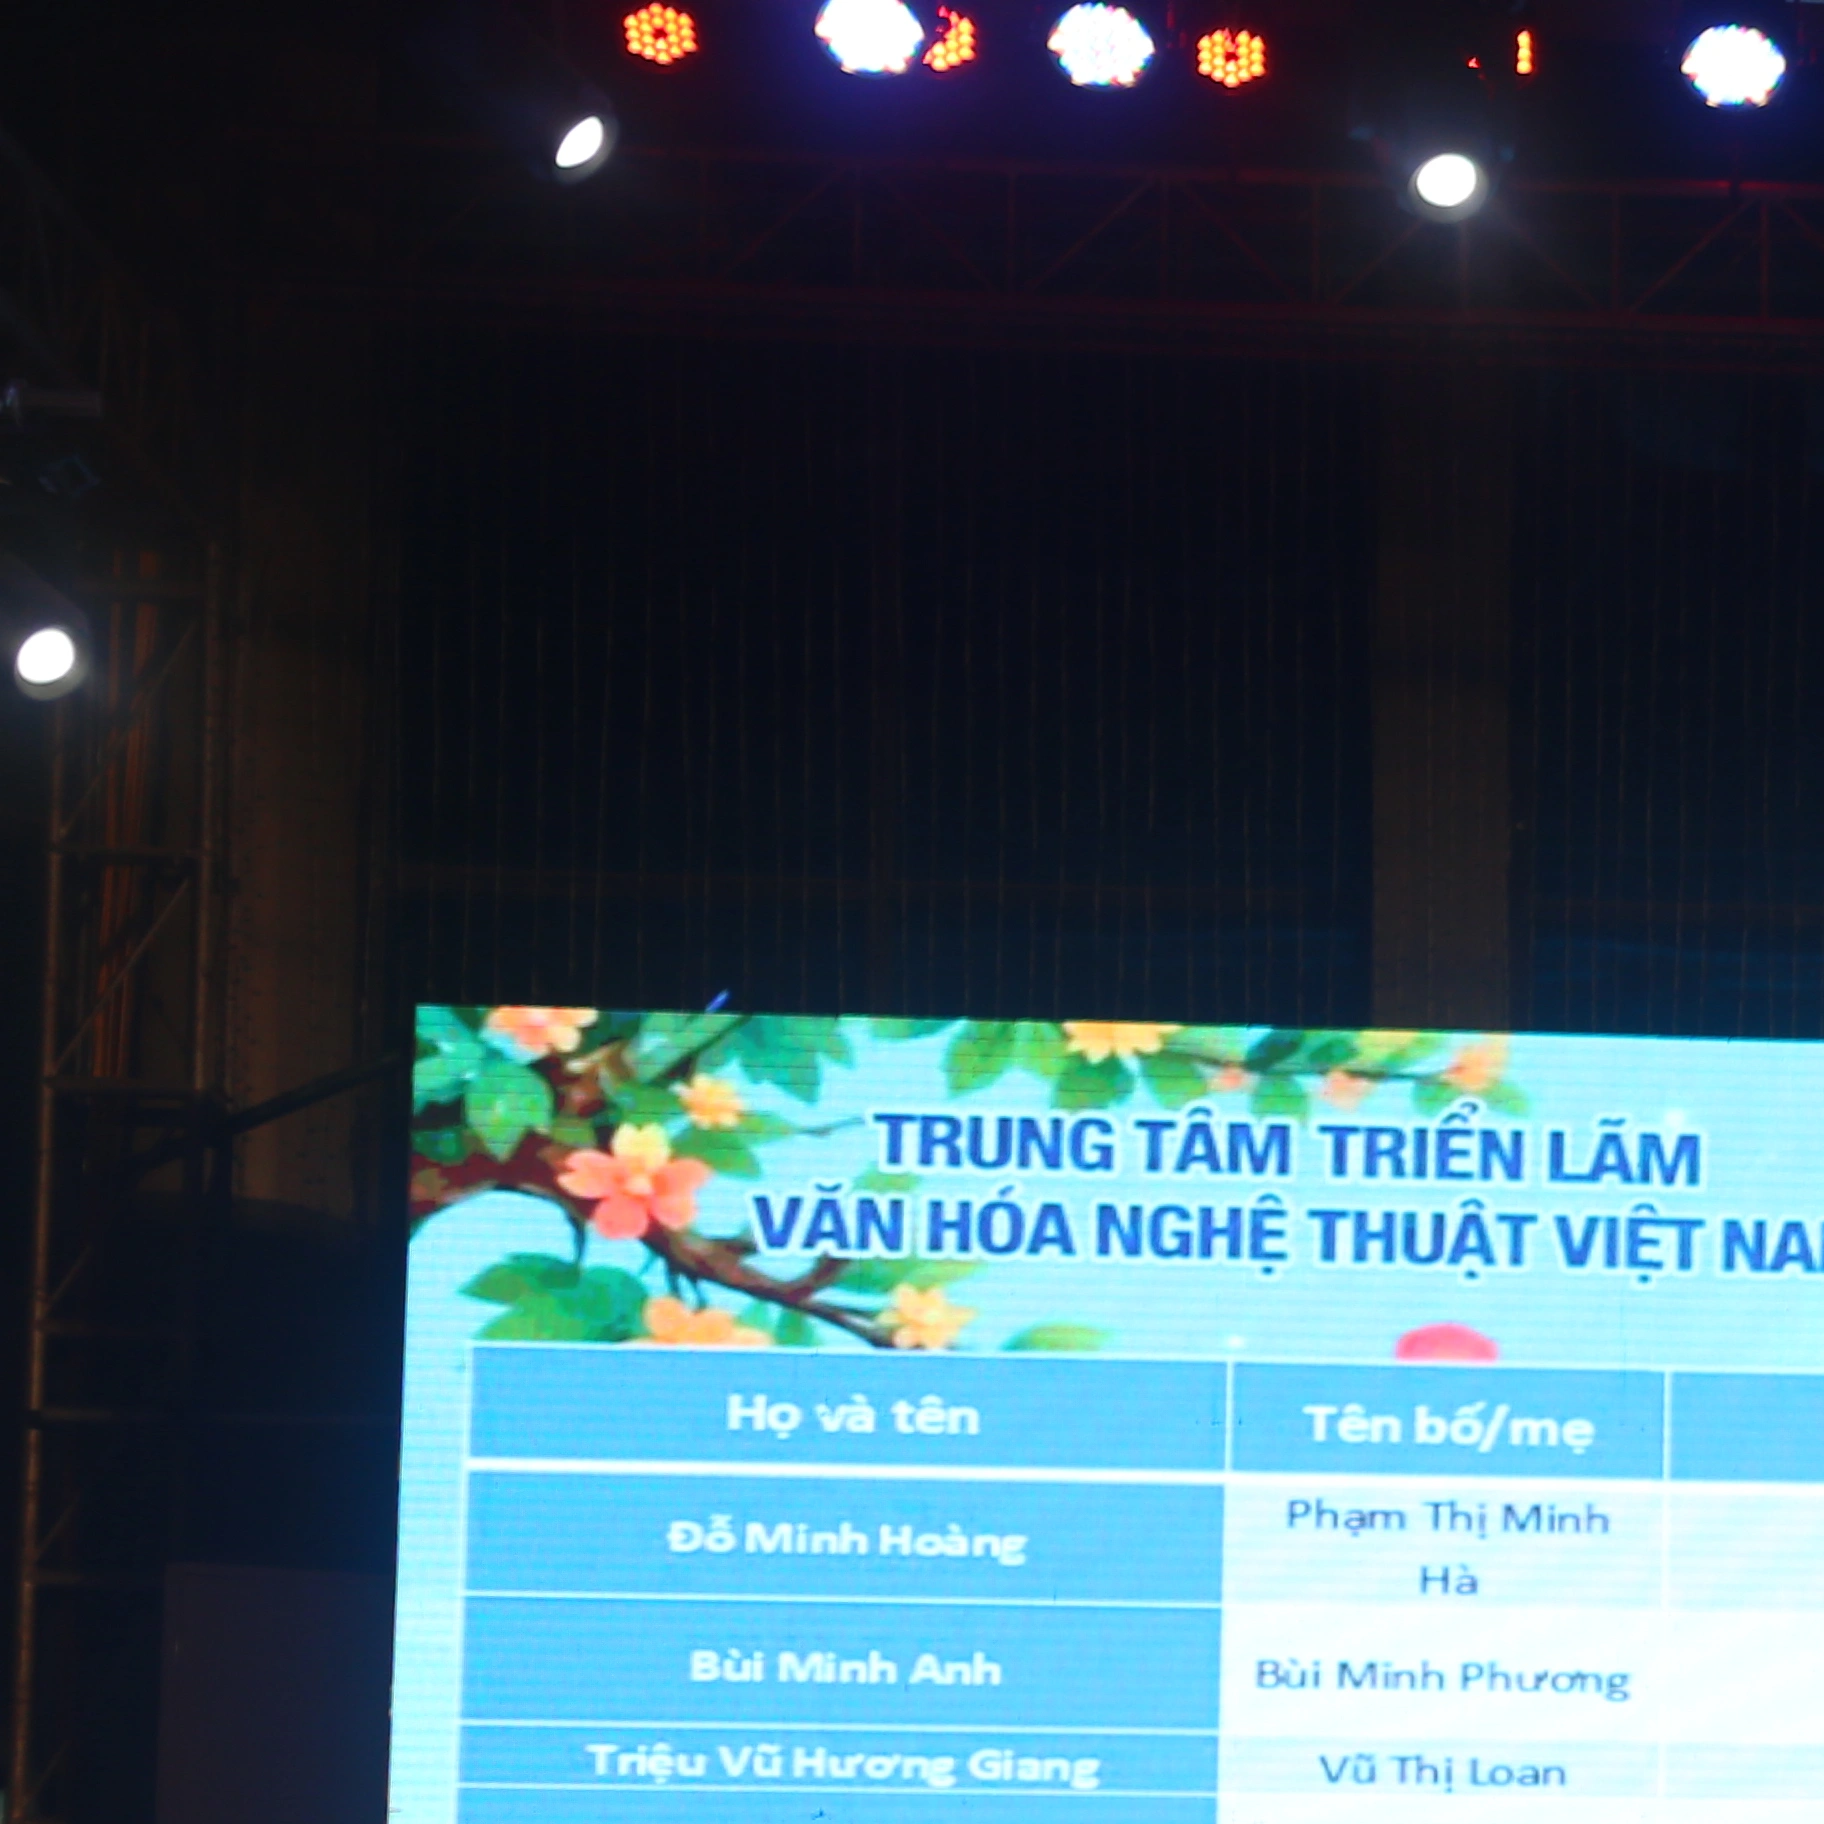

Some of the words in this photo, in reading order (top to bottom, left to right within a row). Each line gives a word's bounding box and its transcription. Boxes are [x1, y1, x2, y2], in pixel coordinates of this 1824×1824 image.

[873, 1112, 1115, 1172] TRUNG
[1134, 1106, 1292, 1176] TÂM
[1317, 1102, 1525, 1182] TRIỂN
[1548, 1117, 1701, 1187] LÃM
[751, 1183, 905, 1251] VĂN
[926, 1184, 1077, 1257] HÓA
[1095, 1191, 1289, 1276] NGHỆ
[1306, 1197, 1539, 1281] THUẬT
[1553, 1201, 1707, 1284] VIỆT
[726, 1393, 804, 1441] Họ
[814, 1392, 877, 1434] và
[889, 1393, 981, 1436] tên
[1301, 1402, 1403, 1445] Tên
[1413, 1400, 1596, 1455] bố/mẹ
[665, 1513, 738, 1554] Đỗ
[744, 1521, 871, 1556] Minh
[877, 1522, 1030, 1568] Hoàng
[1285, 1496, 1408, 1538] Phạm
[1422, 1497, 1489, 1541] Thị
[1500, 1501, 1611, 1535] Minh
[1418, 1562, 1480, 1597] Hà
[689, 1647, 766, 1683] Bùi
[776, 1649, 899, 1685] Minh
[908, 1650, 1003, 1687] Anh
[1254, 1657, 1323, 1692] Bùi
[1335, 1658, 1447, 1693] Minh
[1458, 1658, 1632, 1704] Phương
[584, 1741, 708, 1787] Triệu
[717, 1741, 784, 1779] Vũ
[791, 1745, 958, 1791] Hương
[966, 1747, 1102, 1793] Giang
[1317, 1751, 1378, 1786] Vũ
[1388, 1752, 1455, 1796] Thị
[1467, 1756, 1568, 1789] Loan
